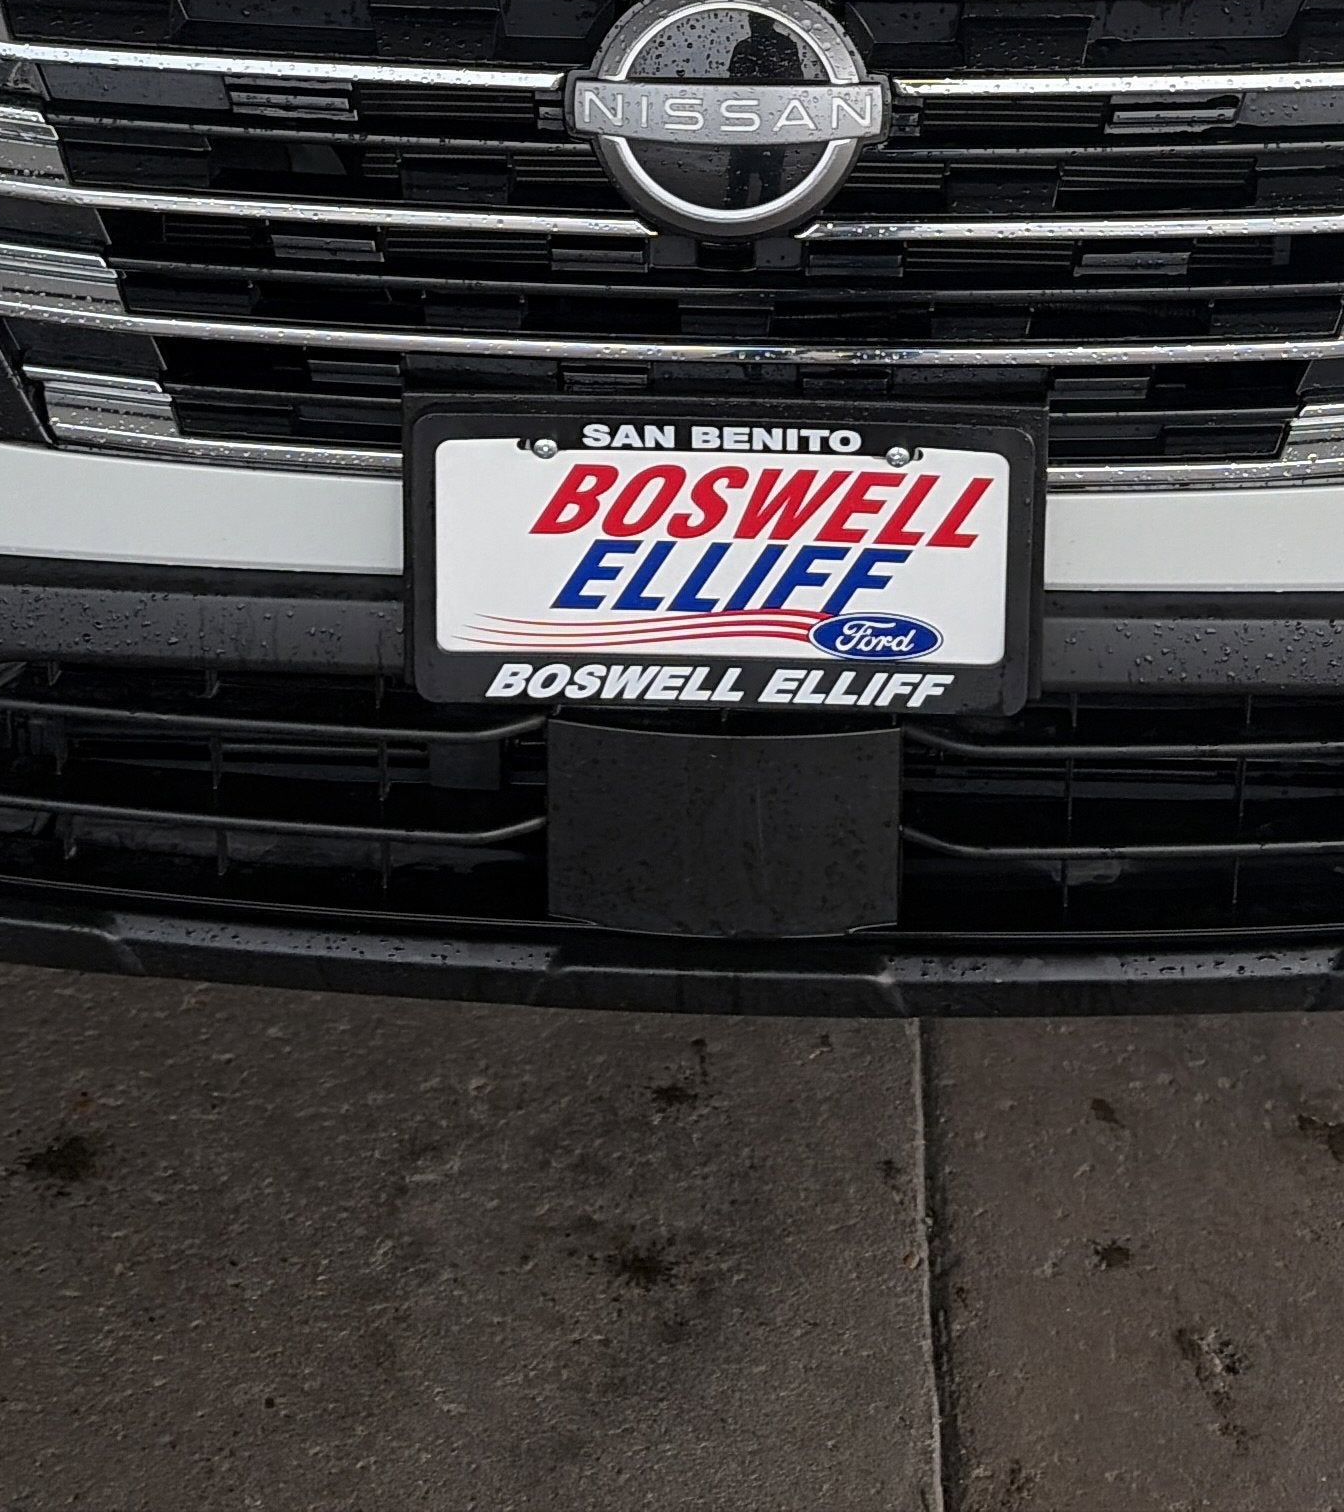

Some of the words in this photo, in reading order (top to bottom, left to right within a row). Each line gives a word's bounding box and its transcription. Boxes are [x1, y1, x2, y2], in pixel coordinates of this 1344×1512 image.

[584, 90, 872, 132] NISSAN
[582, 424, 676, 449] SAN
[691, 427, 862, 453] BENITO
[530, 463, 994, 548] BOSWELL
[549, 540, 912, 616] ELLIFF
[835, 619, 916, 653] Ford
[486, 663, 744, 704] BOSWELL
[757, 668, 955, 707] ELLIFF
